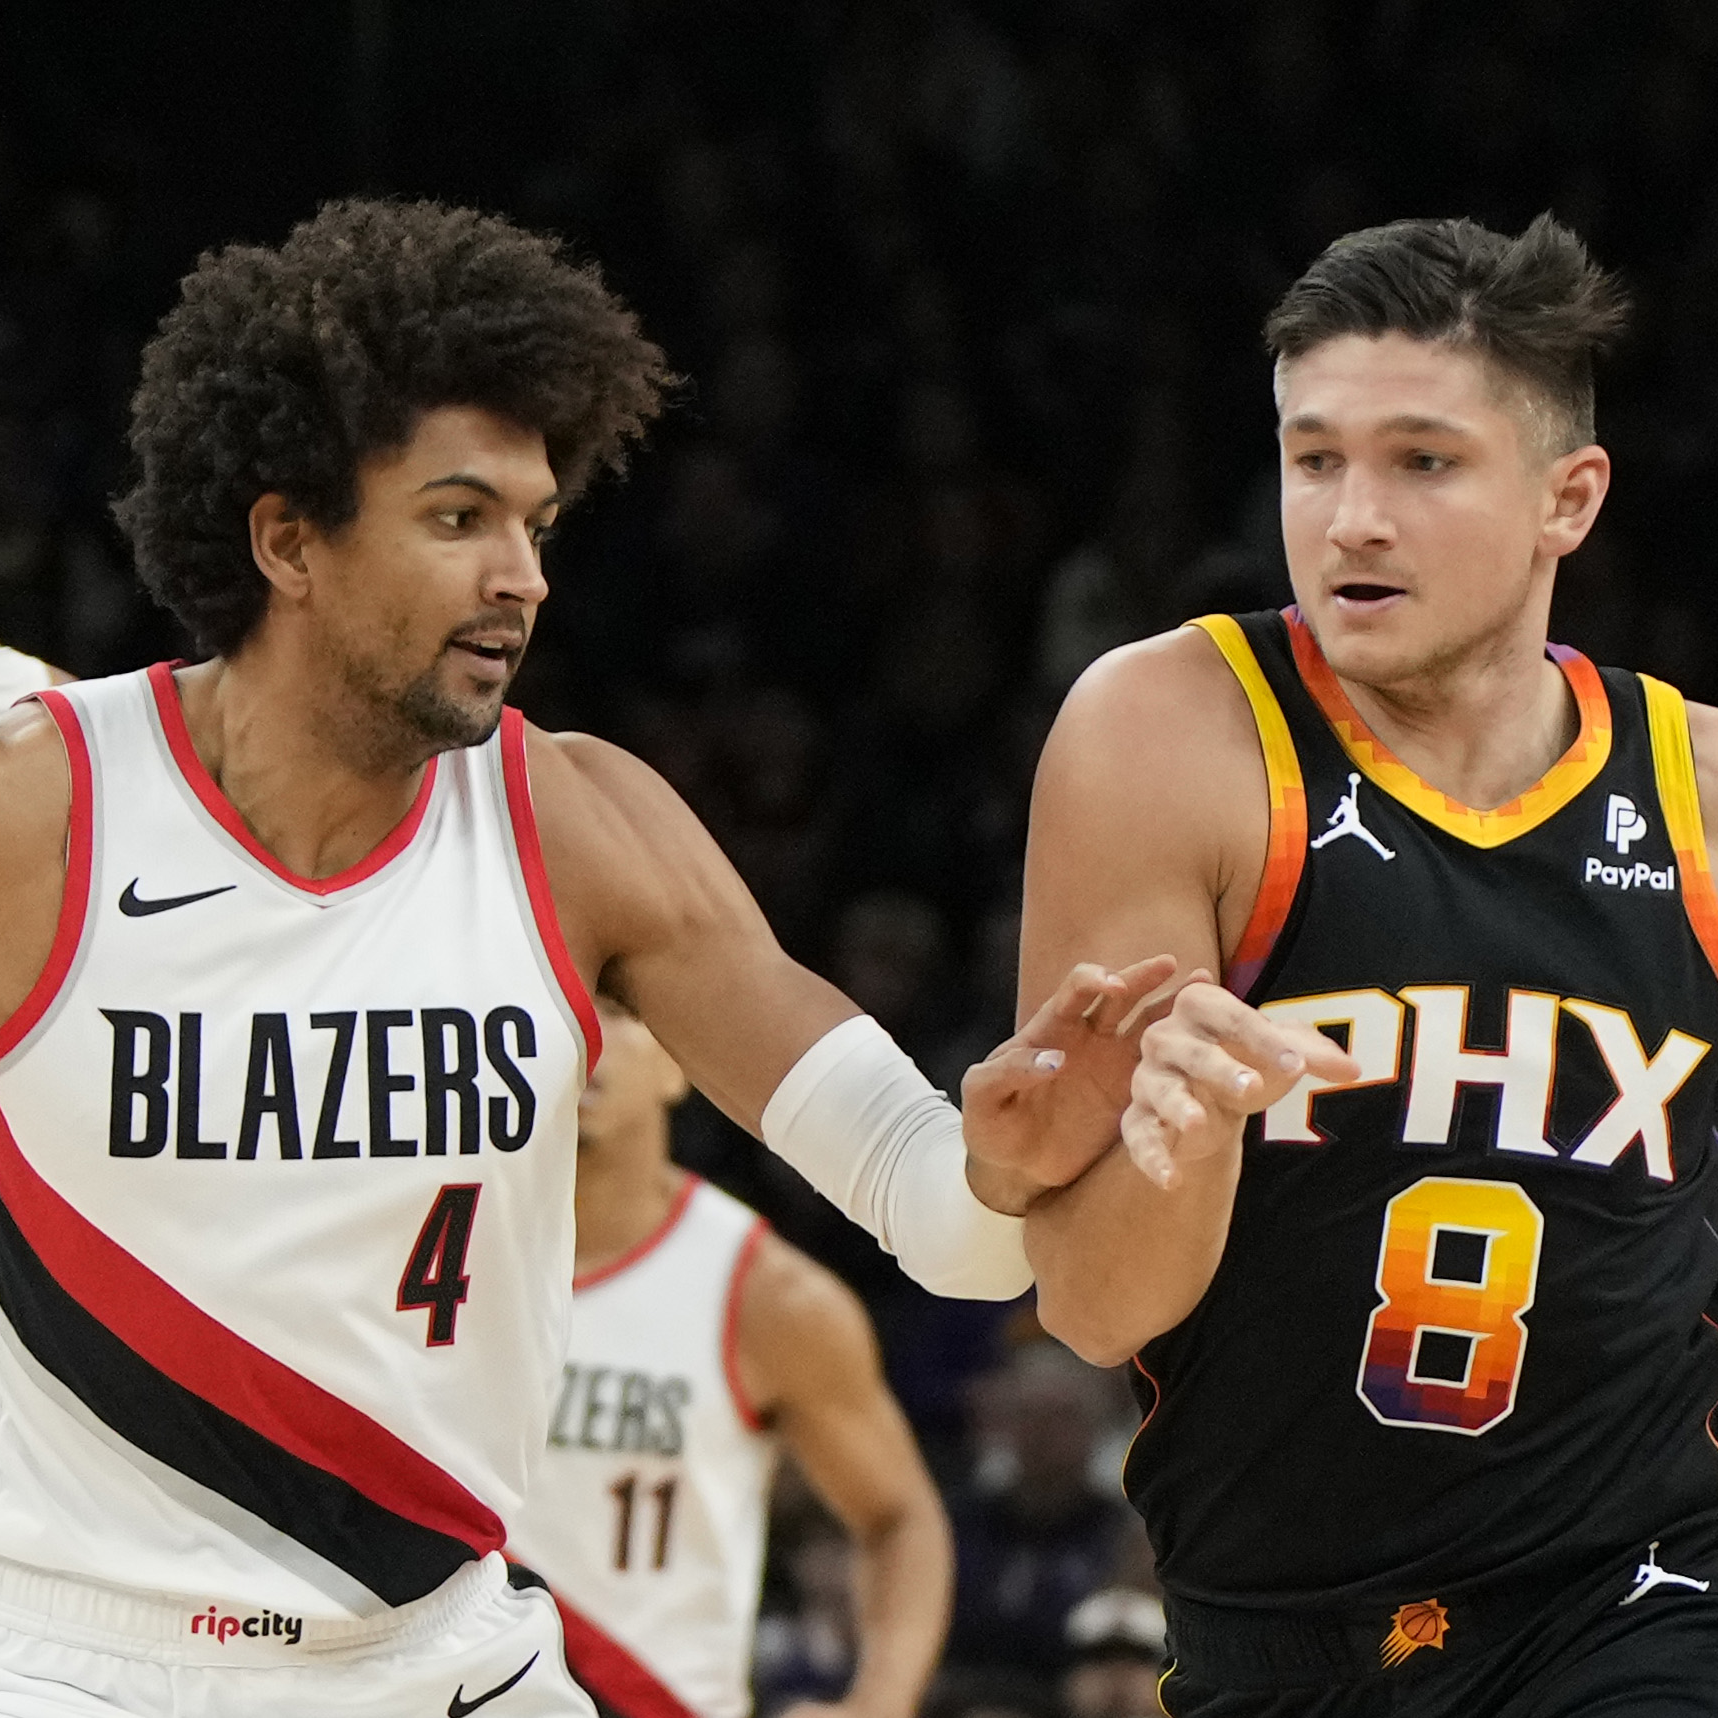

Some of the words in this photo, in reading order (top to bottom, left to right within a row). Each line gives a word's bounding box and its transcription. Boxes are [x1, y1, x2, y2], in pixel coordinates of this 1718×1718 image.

[1585, 857, 1675, 891] PayPal
[98, 1005, 538, 1160] BLAZERS
[1257, 985, 1712, 1183] PHX
[396, 1182, 482, 1347] 4
[1356, 1177, 1544, 1437] 8
[545, 1360, 693, 1457] ZERS
[611, 1472, 677, 1573] 11
[190, 1605, 302, 1646] ripcity
